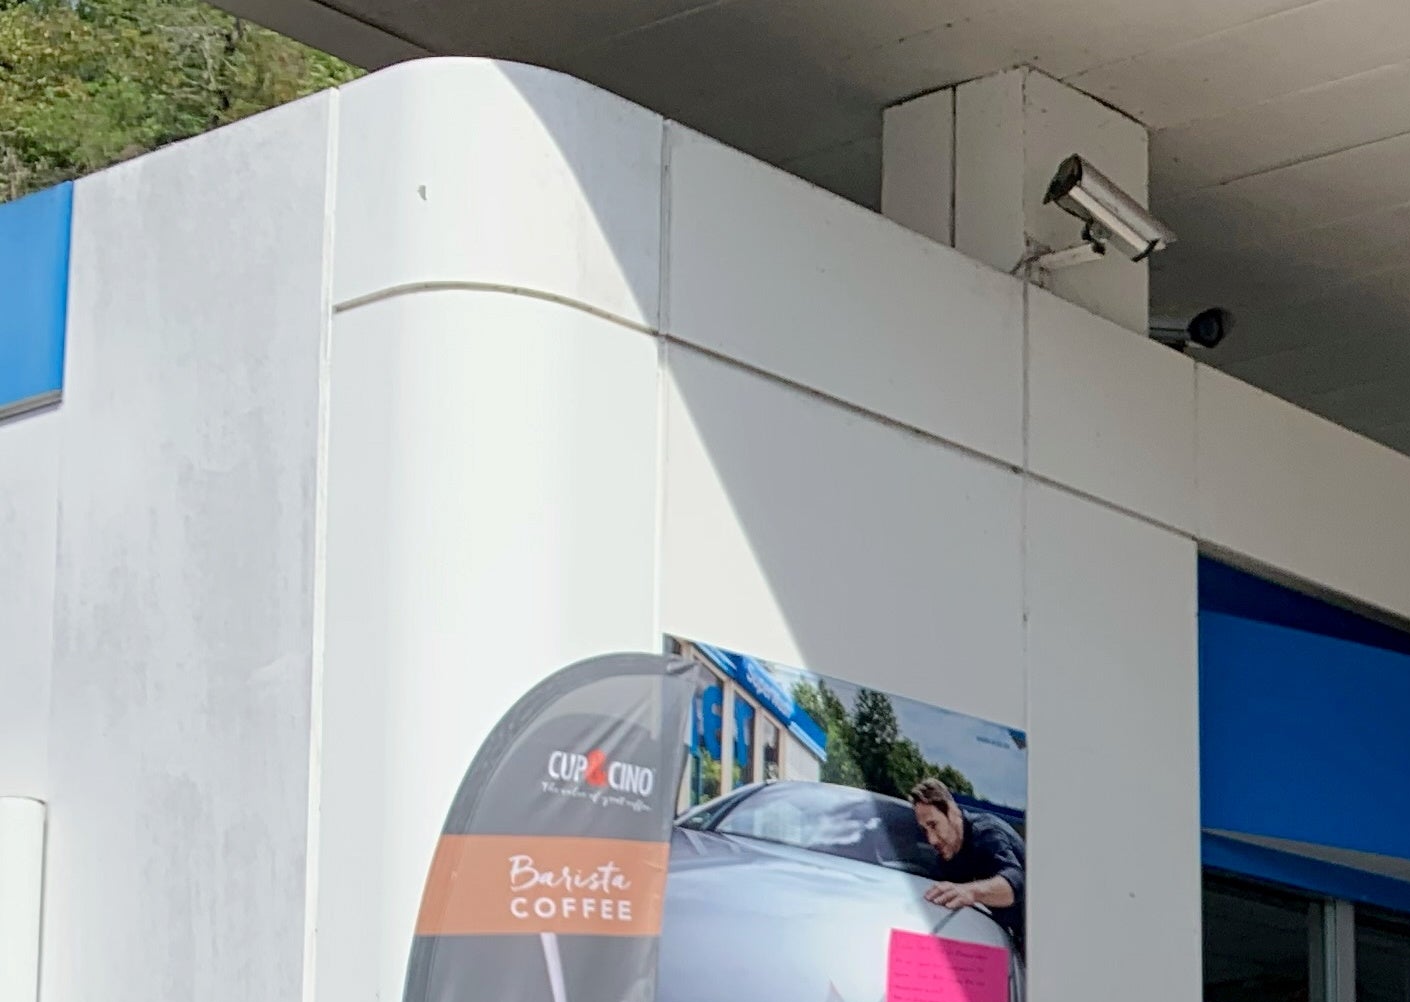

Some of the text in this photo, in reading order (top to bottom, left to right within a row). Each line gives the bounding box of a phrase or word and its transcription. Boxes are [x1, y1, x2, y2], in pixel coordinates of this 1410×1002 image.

[547, 747, 655, 797] CUP&CINO
[508, 854, 632, 894] Barista
[510, 896, 633, 921] COFFEE
